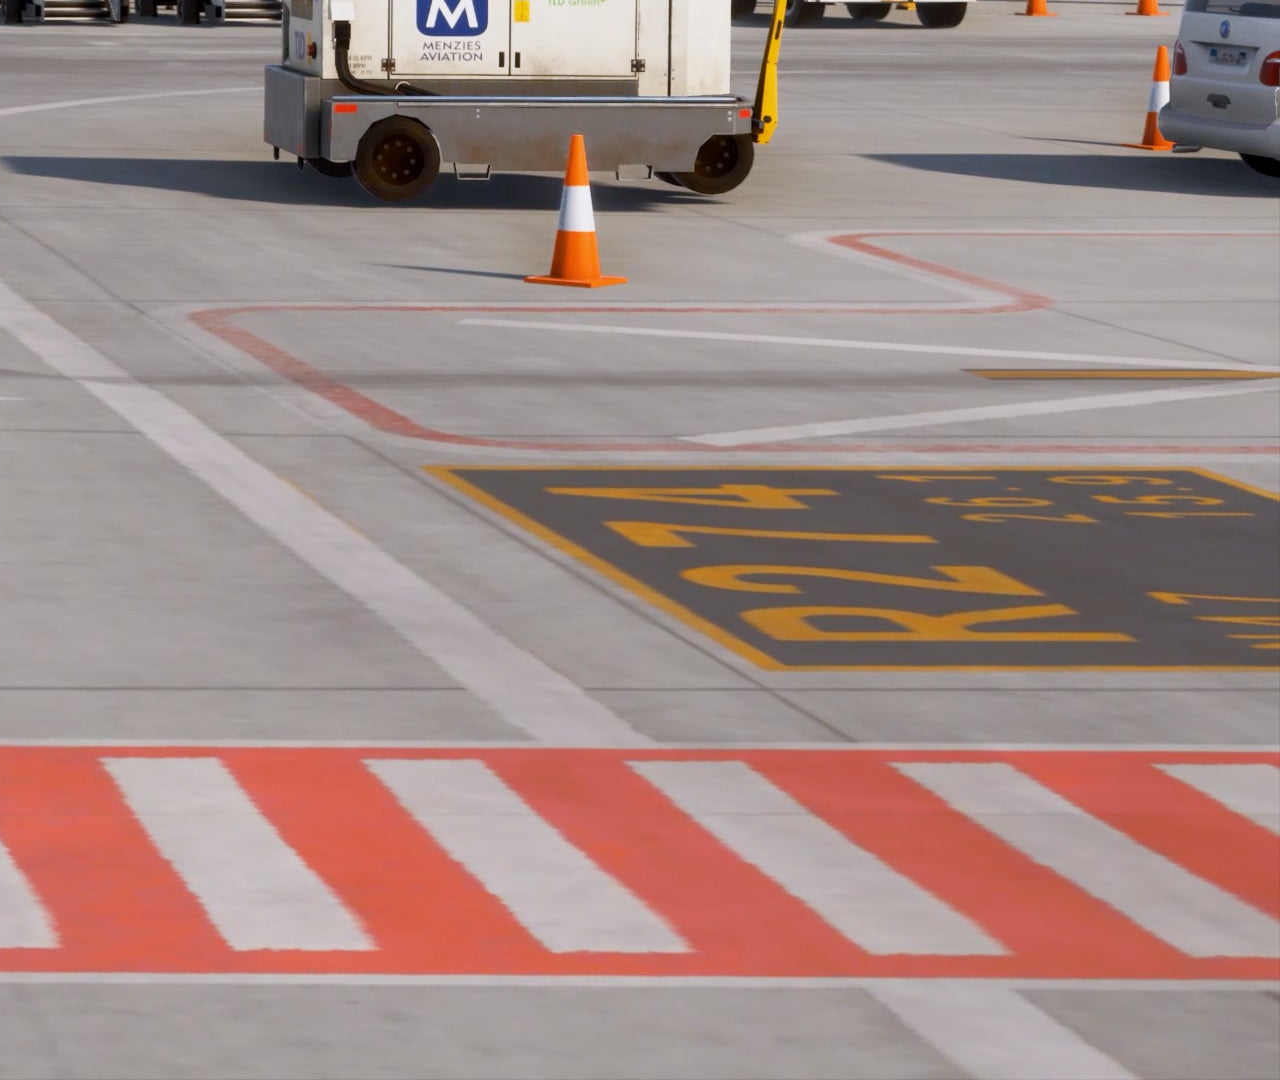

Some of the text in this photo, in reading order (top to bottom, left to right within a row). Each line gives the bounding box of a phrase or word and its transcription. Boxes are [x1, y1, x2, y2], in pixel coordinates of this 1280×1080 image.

[422, 40, 481, 51] MENZIES
[419, 51, 483, 62] AVIATION
[544, 484, 1139, 643] R274
